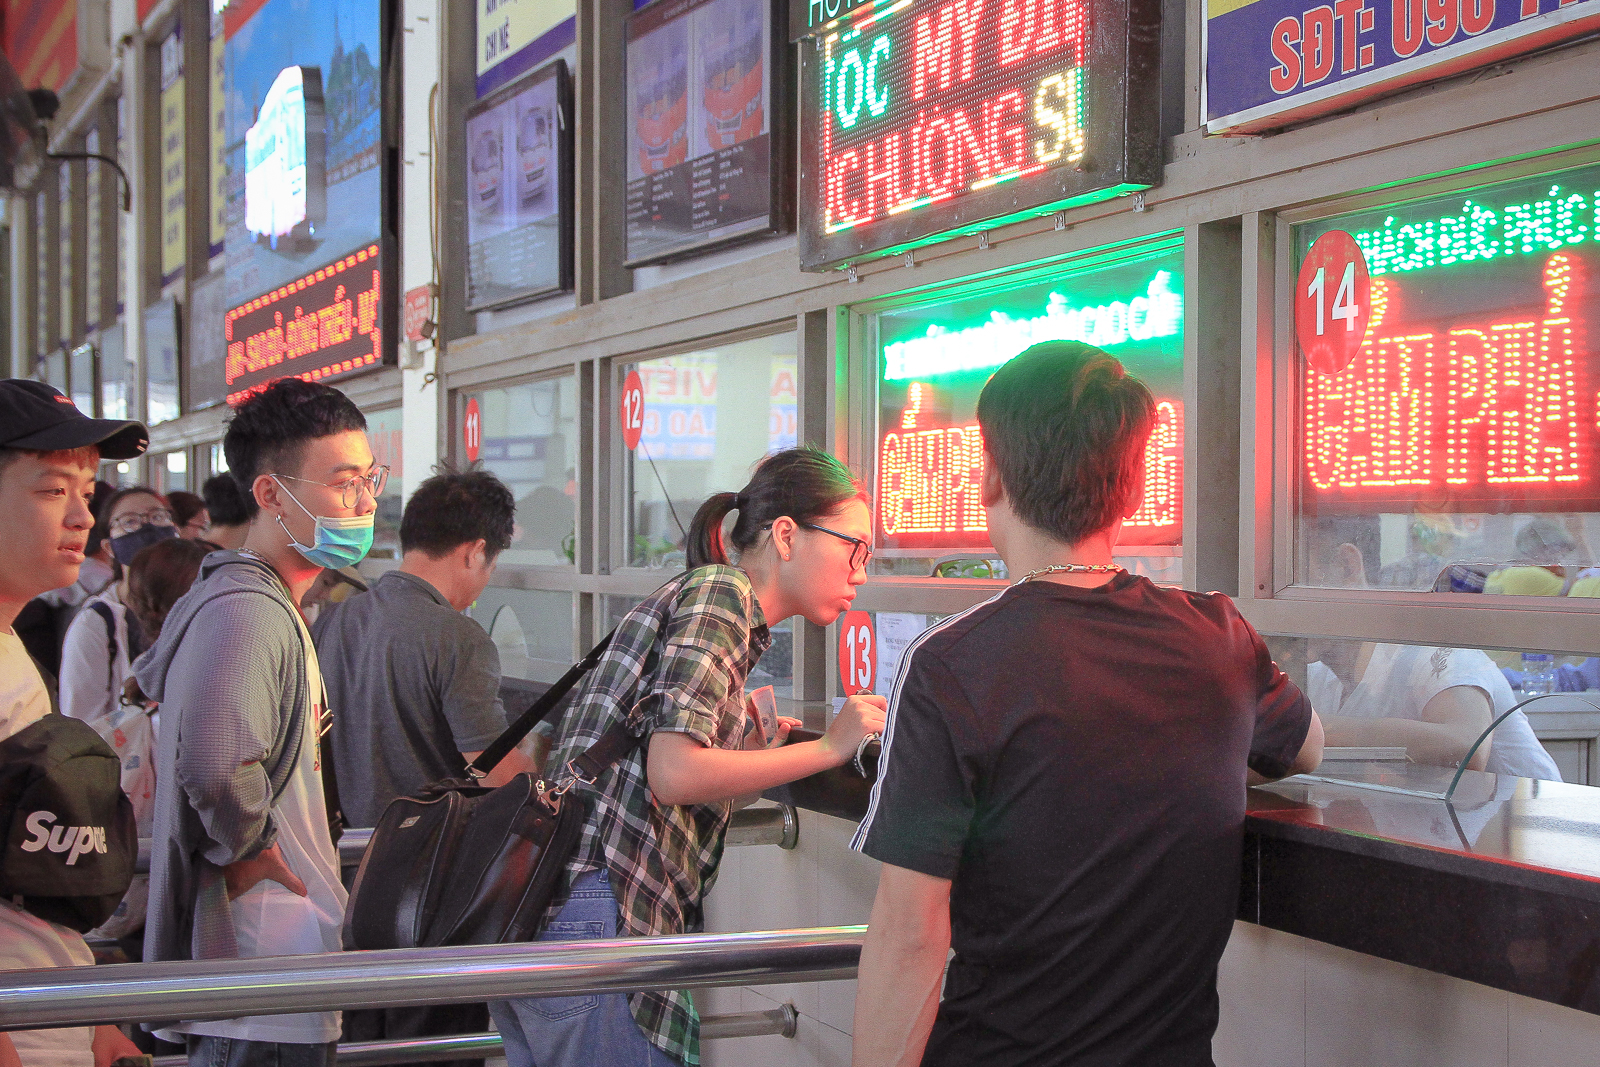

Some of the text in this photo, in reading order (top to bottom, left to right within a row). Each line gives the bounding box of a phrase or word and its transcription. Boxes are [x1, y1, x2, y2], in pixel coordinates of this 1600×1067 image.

[1306, 261, 1359, 336] 14
[465, 415, 479, 449] 11
[622, 388, 642, 430] 12
[846, 625, 872, 689] 13
